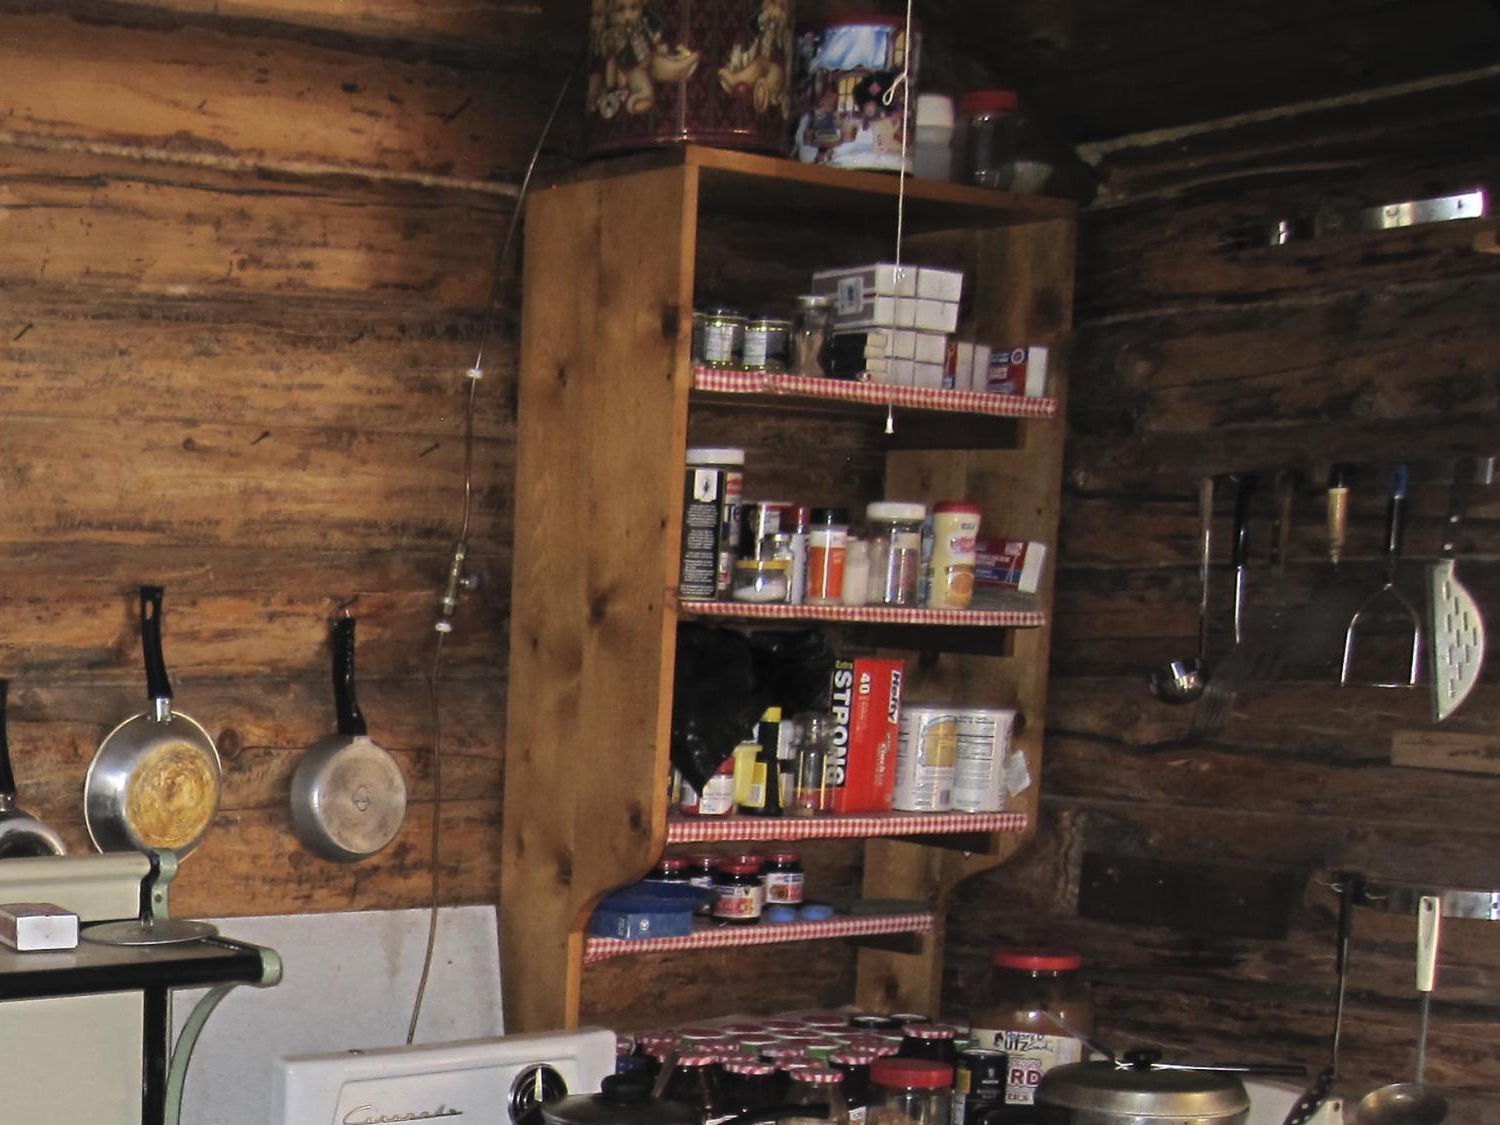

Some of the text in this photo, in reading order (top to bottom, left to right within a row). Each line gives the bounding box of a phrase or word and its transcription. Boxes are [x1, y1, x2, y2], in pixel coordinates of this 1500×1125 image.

[859, 671, 871, 695] 40
[888, 670, 901, 724] Hefty
[825, 670, 852, 785] STRONG
[1010, 1068, 1042, 1087] RD
